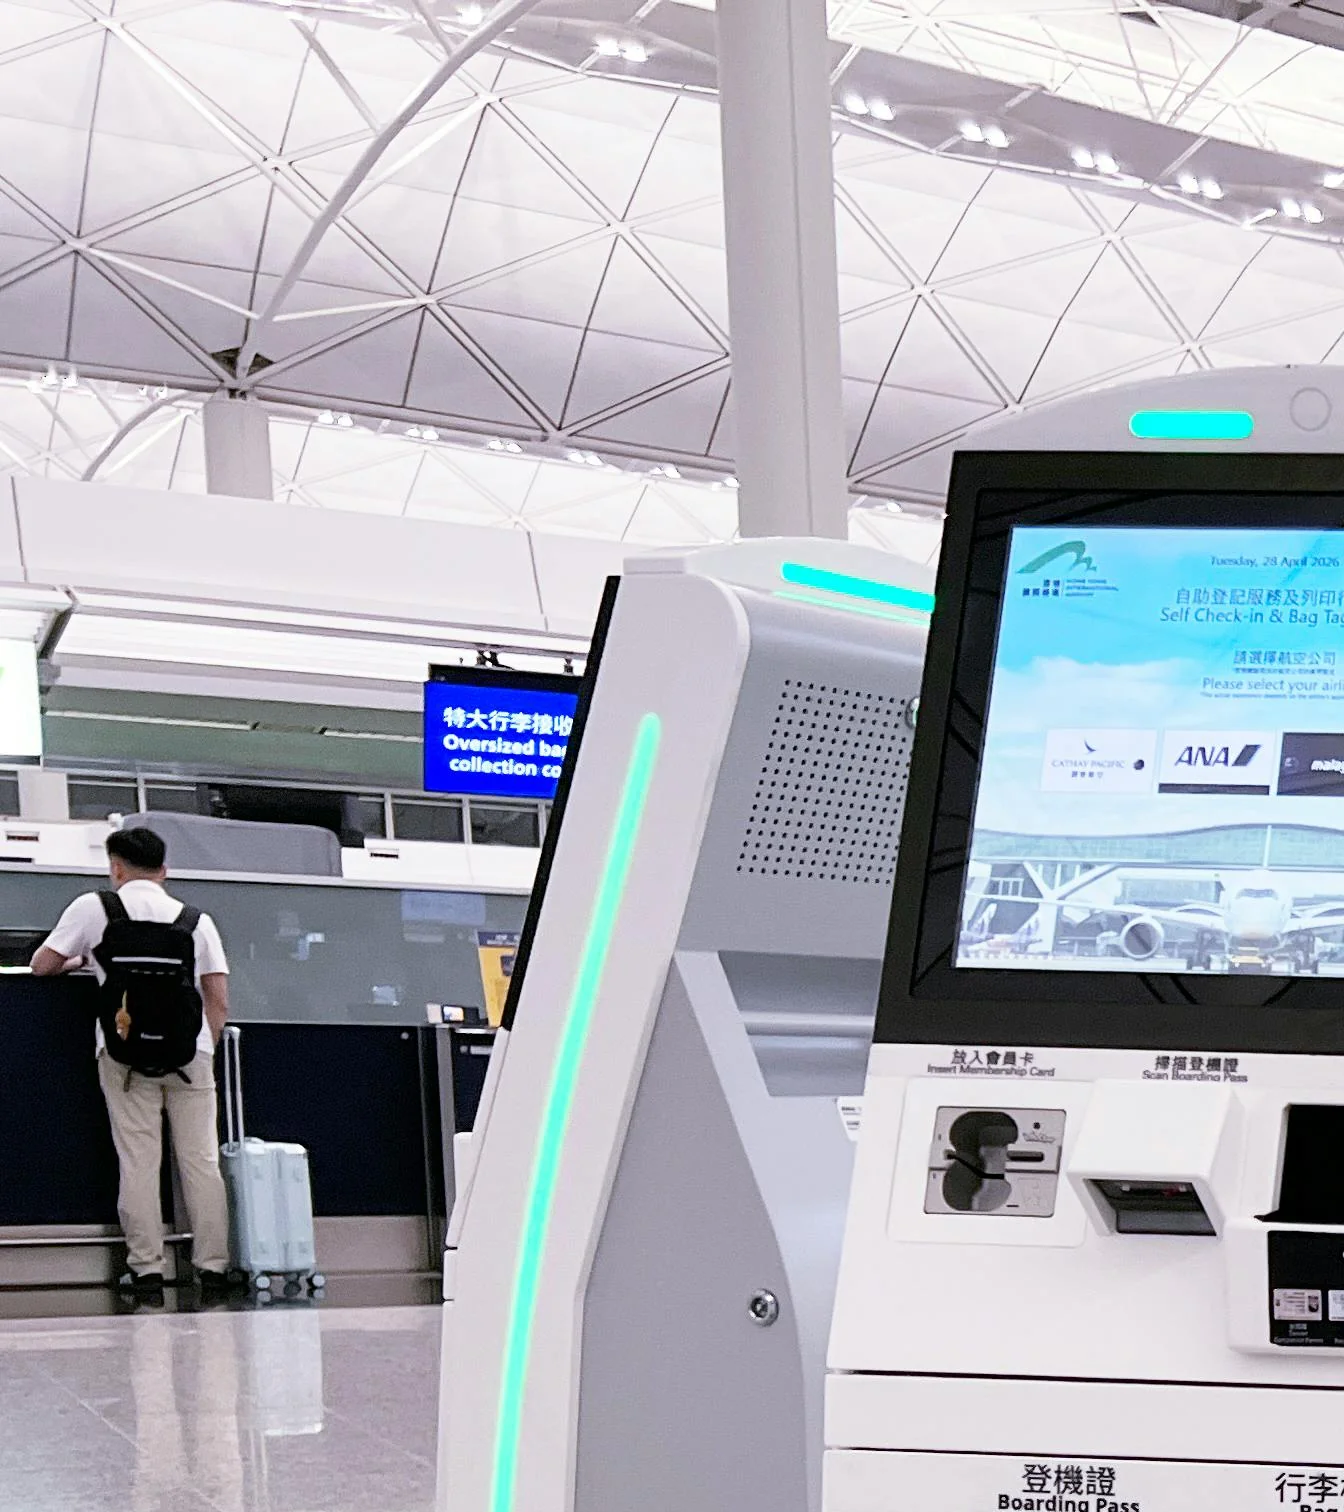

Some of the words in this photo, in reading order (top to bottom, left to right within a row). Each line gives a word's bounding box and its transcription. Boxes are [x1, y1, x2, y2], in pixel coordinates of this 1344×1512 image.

[1210, 556, 1258, 568] Tuesday,
[1280, 557, 1308, 568] April
[1311, 557, 1340, 567] 2026
[1159, 608, 1189, 622] Self
[1194, 608, 1264, 624] Check-in
[1269, 609, 1284, 624] &
[1288, 609, 1318, 627] Bag
[1202, 677, 1244, 691] Please
[1247, 678, 1285, 691] select
[1288, 681, 1321, 694] your
[442, 733, 535, 756] Oversized
[1174, 746, 1230, 767] ANA
[449, 756, 537, 777] collection
[951, 1048, 1035, 1066] 放入會員卡
[927, 1063, 958, 1075] Insert
[959, 1065, 1028, 1078] Membership
[1029, 1066, 1056, 1078] Card
[1142, 1069, 1170, 1081] Scan
[1171, 1070, 1221, 1083] Boarding
[1222, 1072, 1248, 1084] Pass
[1020, 1463, 1117, 1498] 登機證
